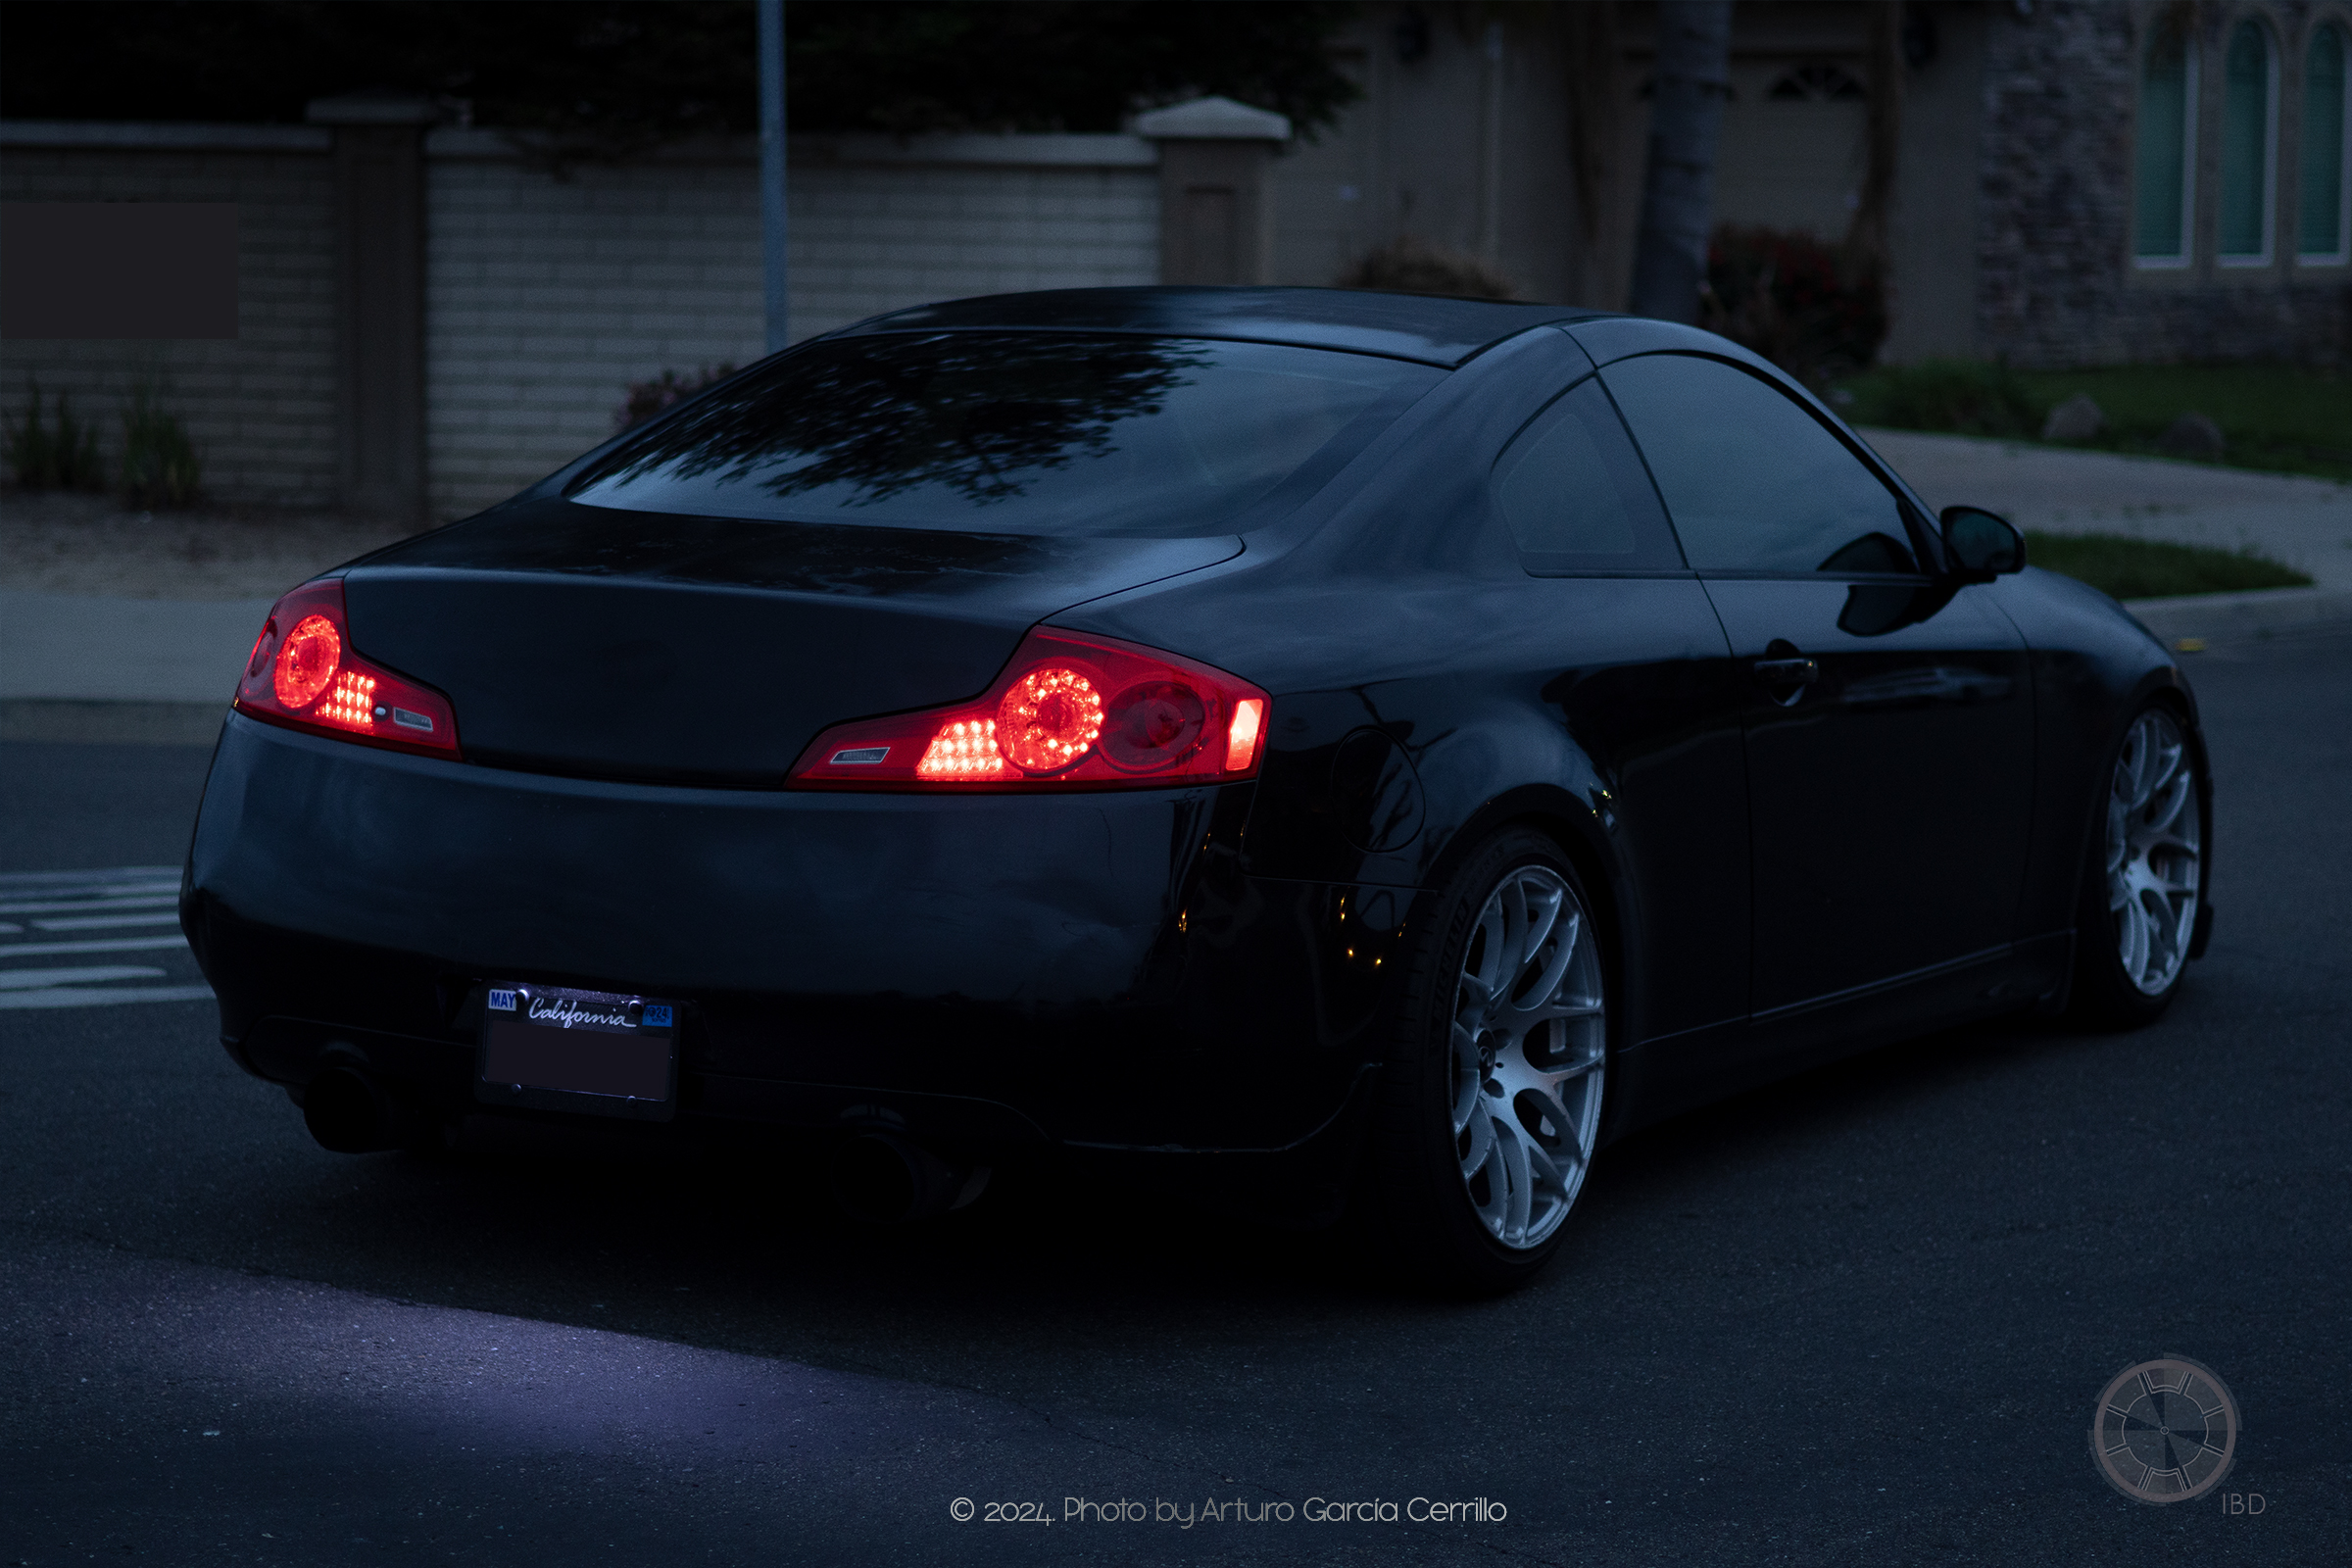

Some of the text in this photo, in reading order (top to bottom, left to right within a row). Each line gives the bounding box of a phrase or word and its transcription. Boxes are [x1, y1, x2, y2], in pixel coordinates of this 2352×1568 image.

[1433, 898, 1468, 1022] MICHELIN
[491, 992, 516, 1008] MAY
[529, 998, 637, 1028] California
